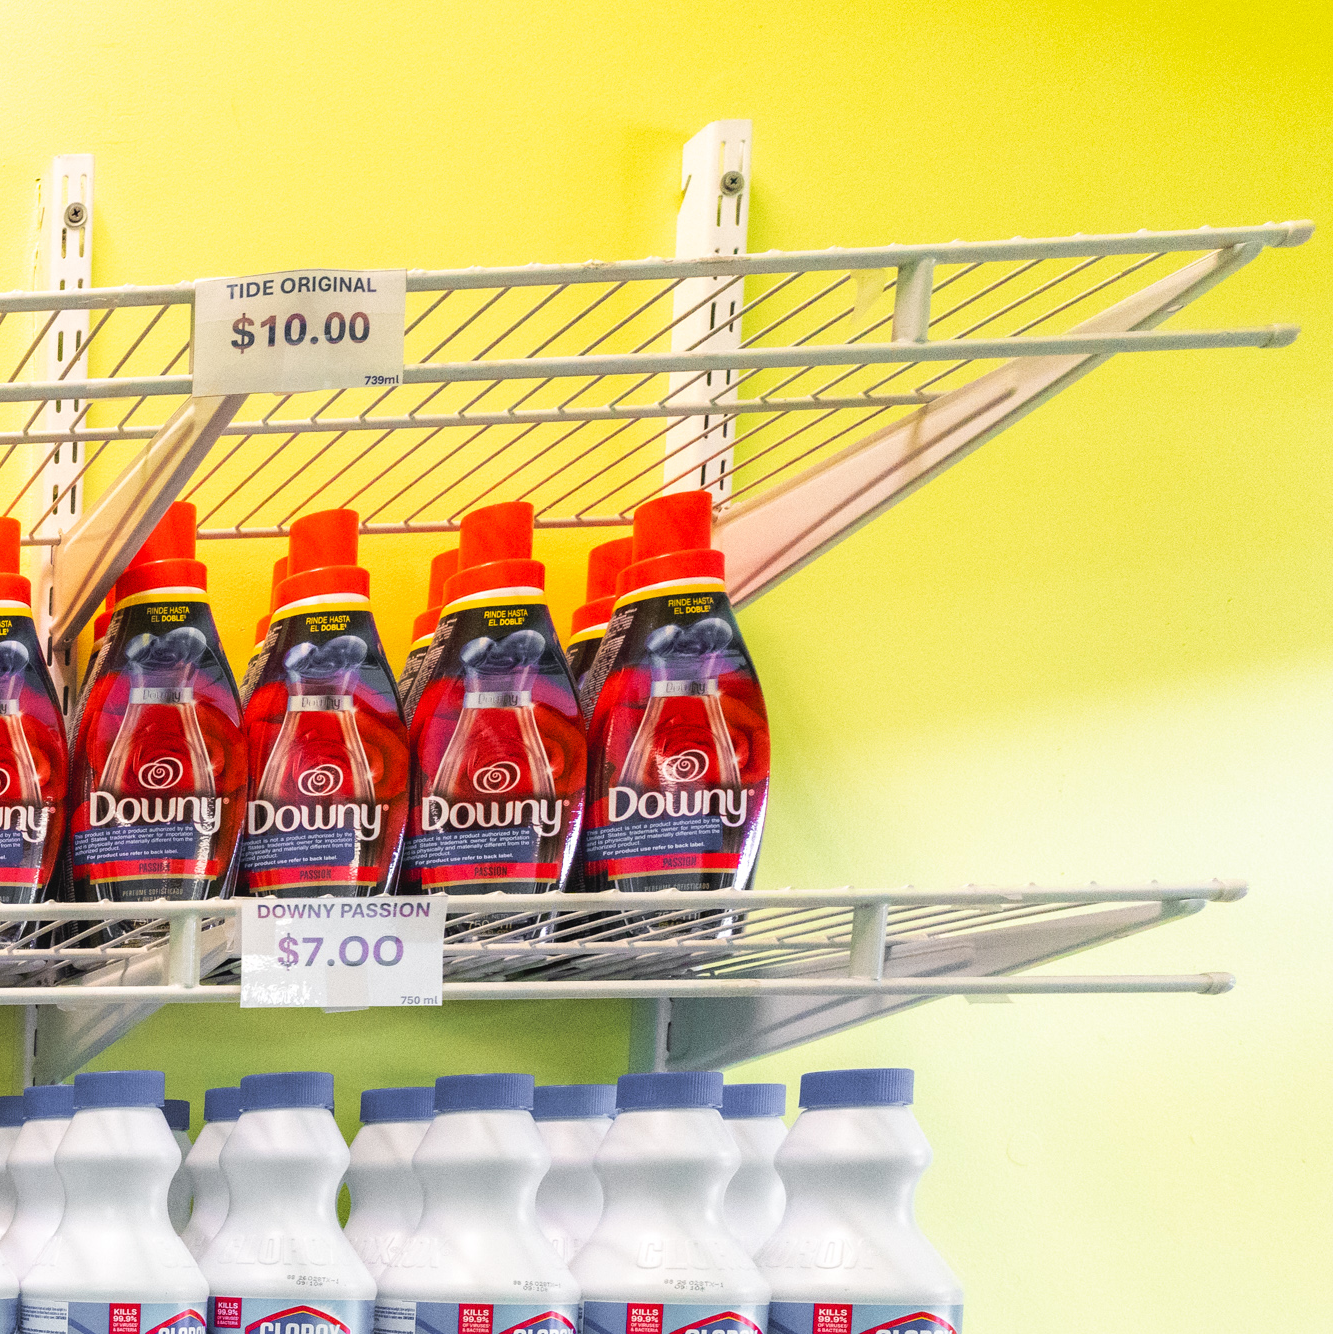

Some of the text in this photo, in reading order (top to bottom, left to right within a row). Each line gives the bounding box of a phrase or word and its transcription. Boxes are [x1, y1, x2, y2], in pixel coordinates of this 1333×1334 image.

[227, 276, 376, 299] TIDE ORIGINAL
[231, 311, 370, 354] $10.00
[364, 375, 399, 385] 739ml
[668, 598, 690, 607] RINDE
[674, 606, 683, 614] EL
[608, 786, 747, 827] Downy
[423, 797, 563, 836] Downy
[475, 865, 507, 876] PASSION
[258, 902, 430, 919] DOWNY PASSION
[277, 933, 404, 971] $7.00
[423, 996, 438, 1004] ml
